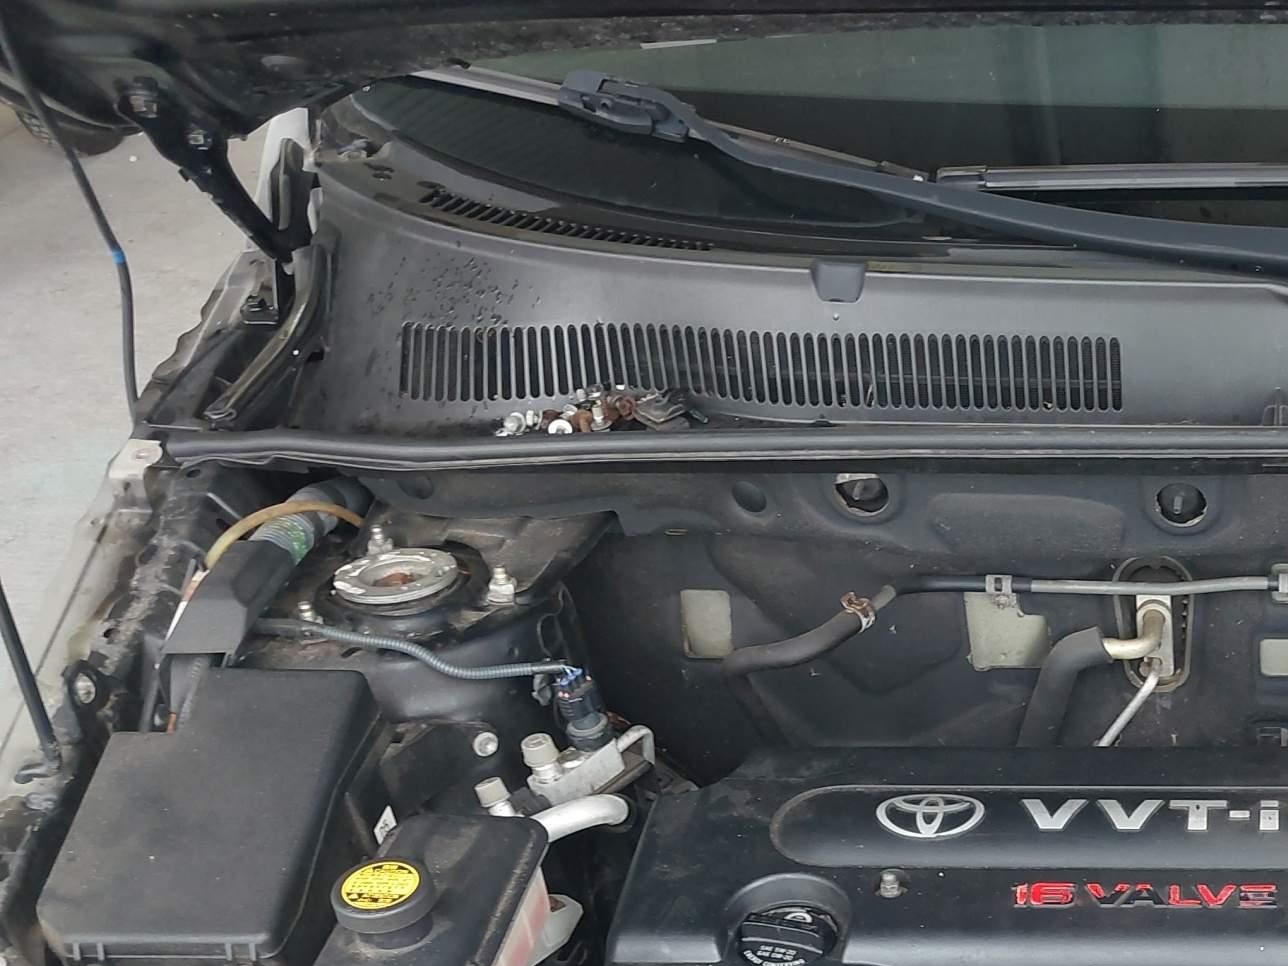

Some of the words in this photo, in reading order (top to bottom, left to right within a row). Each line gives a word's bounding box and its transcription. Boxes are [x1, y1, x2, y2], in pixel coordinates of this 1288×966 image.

[1020, 797, 1281, 832] VVT-i
[1012, 881, 1075, 907] 16
[1083, 882, 1279, 909] VALVE
